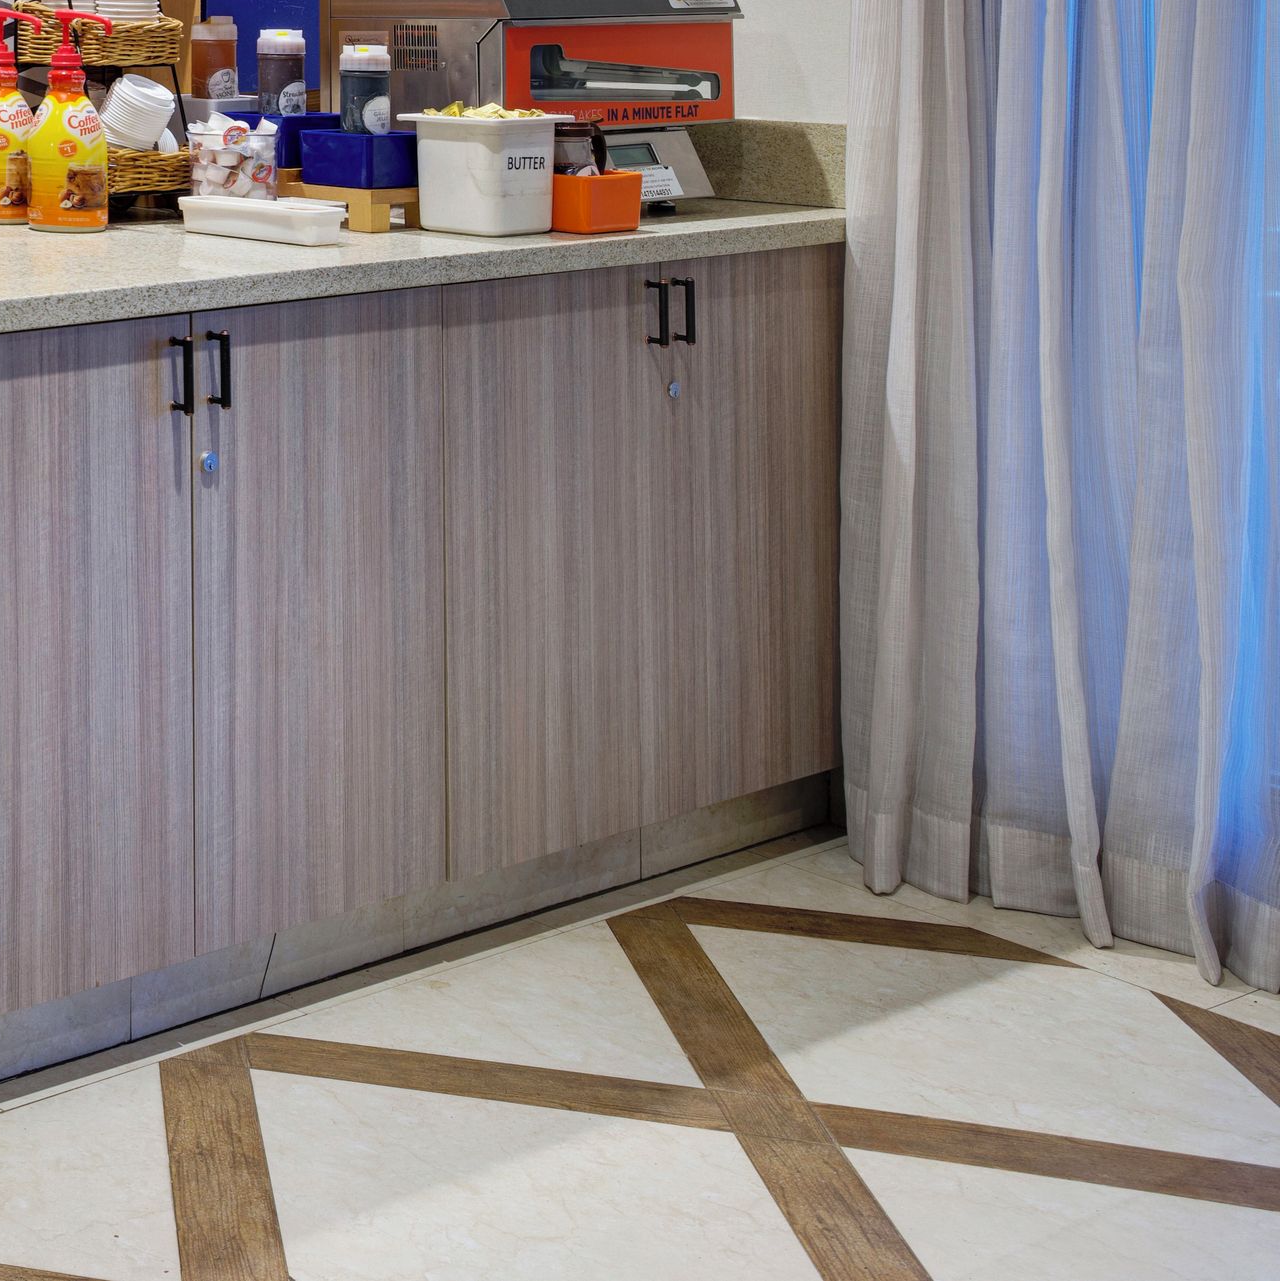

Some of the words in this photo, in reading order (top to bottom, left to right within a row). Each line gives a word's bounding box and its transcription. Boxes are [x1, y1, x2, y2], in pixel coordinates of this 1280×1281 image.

[607, 108, 618, 121] IN
[622, 107, 629, 121] A
[632, 106, 672, 120] MINUTE
[675, 104, 699, 118] FLAT
[507, 156, 546, 170] BUTTER
